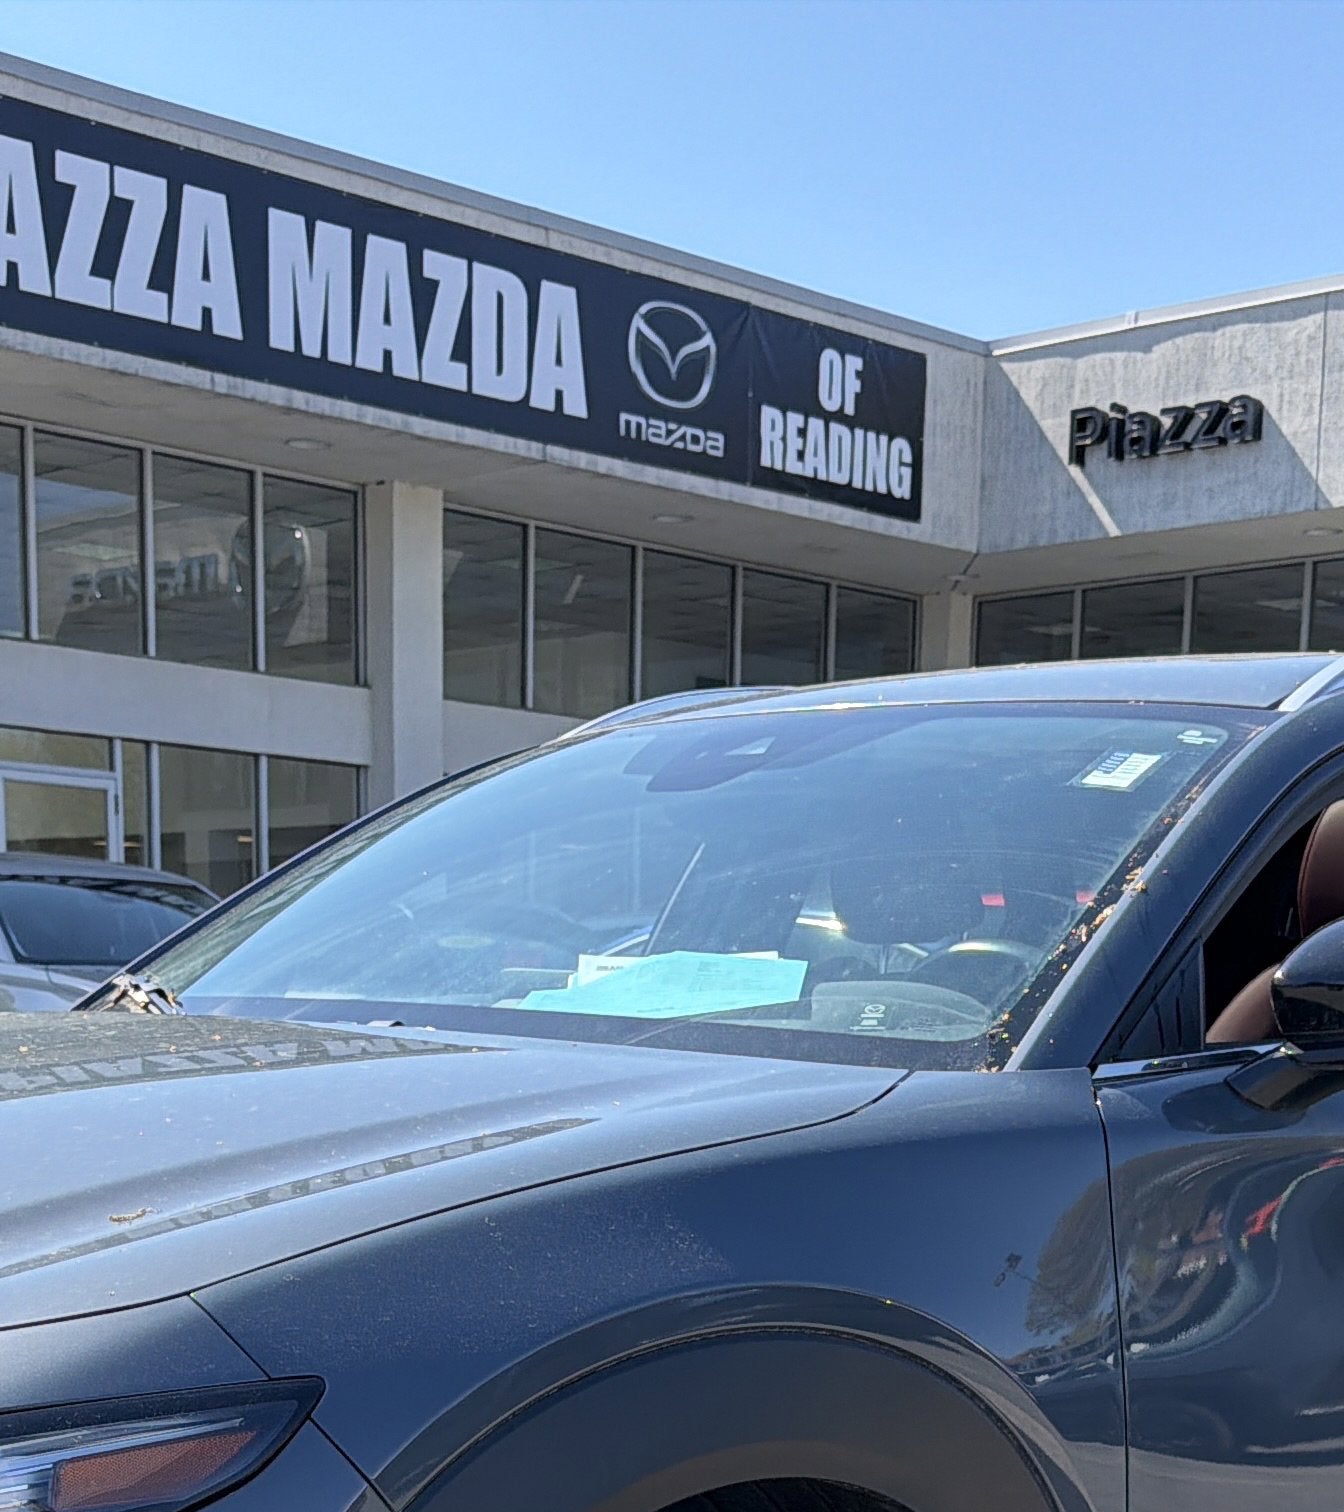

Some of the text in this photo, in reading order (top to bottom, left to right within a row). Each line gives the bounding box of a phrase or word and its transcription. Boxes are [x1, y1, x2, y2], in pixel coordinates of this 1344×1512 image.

[268, 206, 589, 419] MAZDA
[818, 347, 864, 417] OF
[759, 404, 913, 501] READING
[1068, 394, 1263, 467] Piazza
